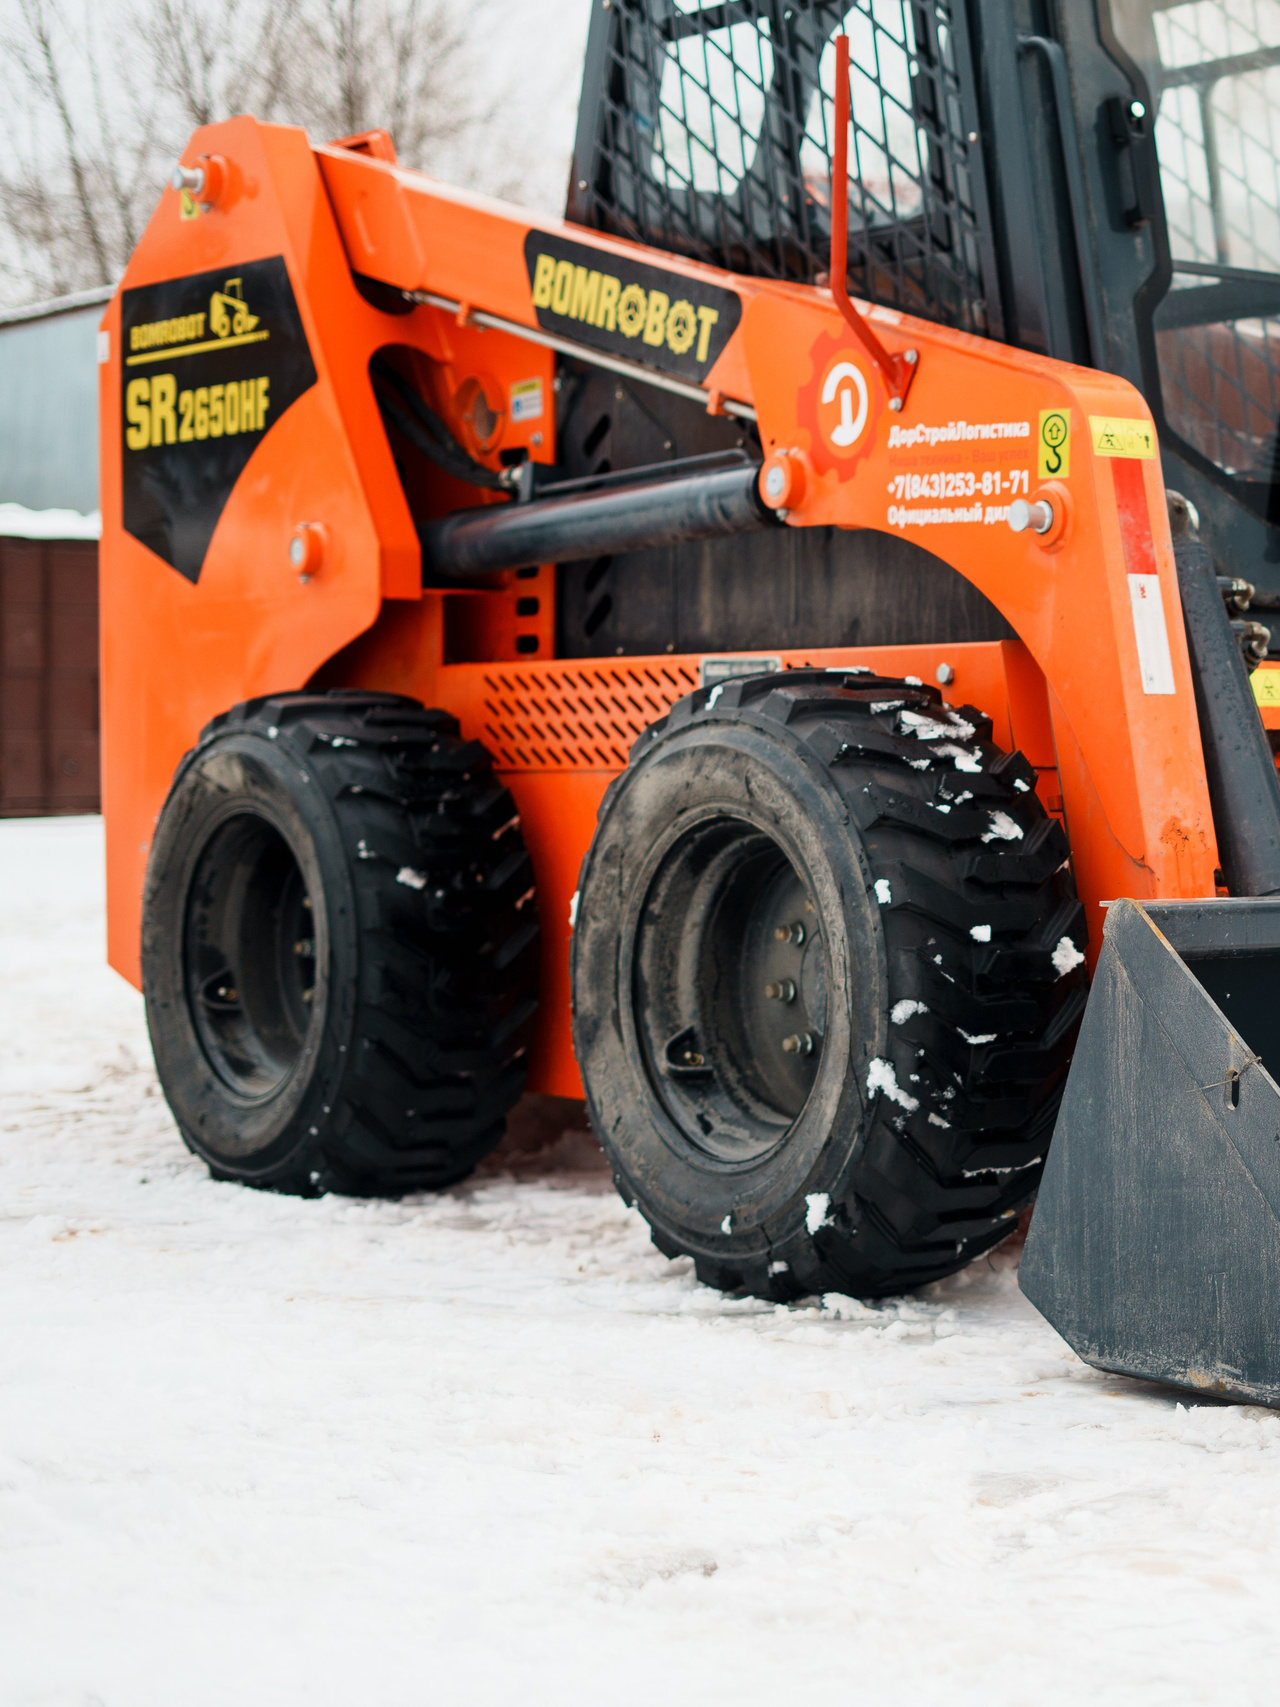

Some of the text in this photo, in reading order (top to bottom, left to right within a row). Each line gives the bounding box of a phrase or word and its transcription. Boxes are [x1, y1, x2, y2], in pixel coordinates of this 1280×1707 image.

[532, 253, 719, 363] BOMROBOT
[130, 312, 206, 351] BOMROBOT
[888, 421, 1030, 449] ДорСтройЛогистика
[887, 469, 1029, 501] +7(843)253-81-71
[887, 502, 1011, 529] Официальный дил
